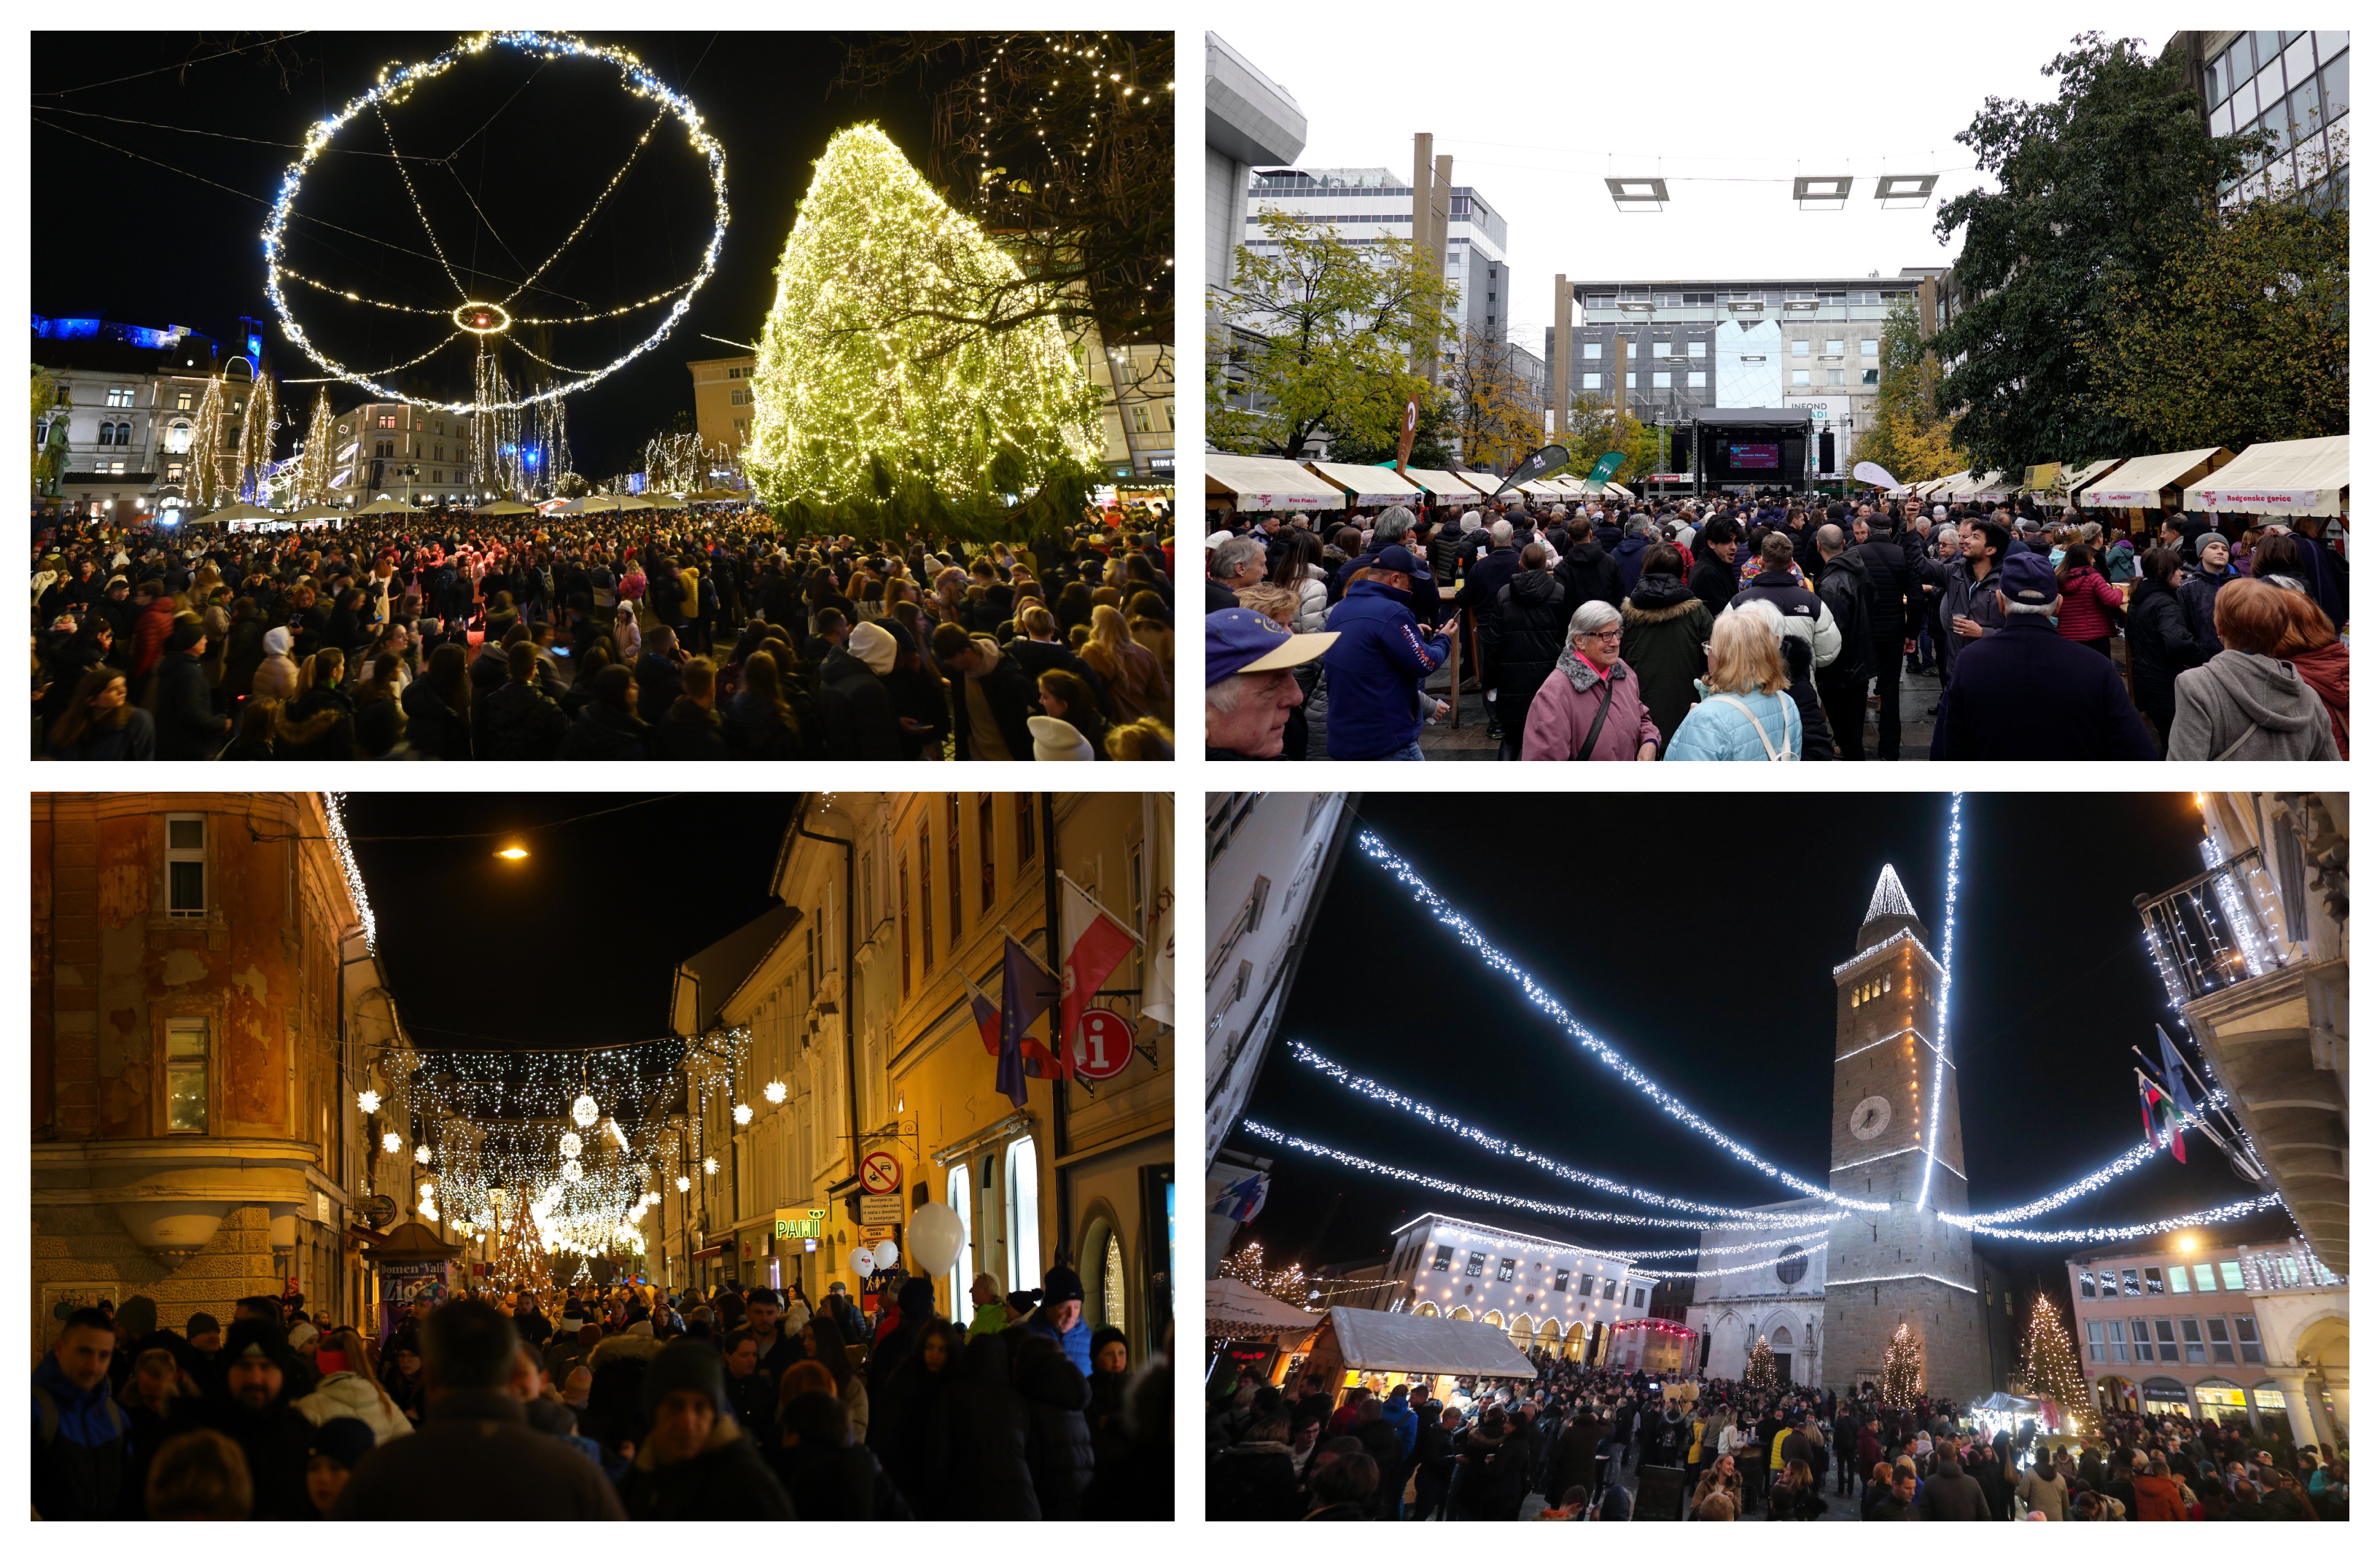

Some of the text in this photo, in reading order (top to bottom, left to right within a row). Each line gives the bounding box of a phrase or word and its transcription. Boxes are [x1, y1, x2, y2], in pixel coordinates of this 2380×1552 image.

[2227, 494, 2292, 504] Radgonske gorice
[381, 1264, 419, 1274] Domen
